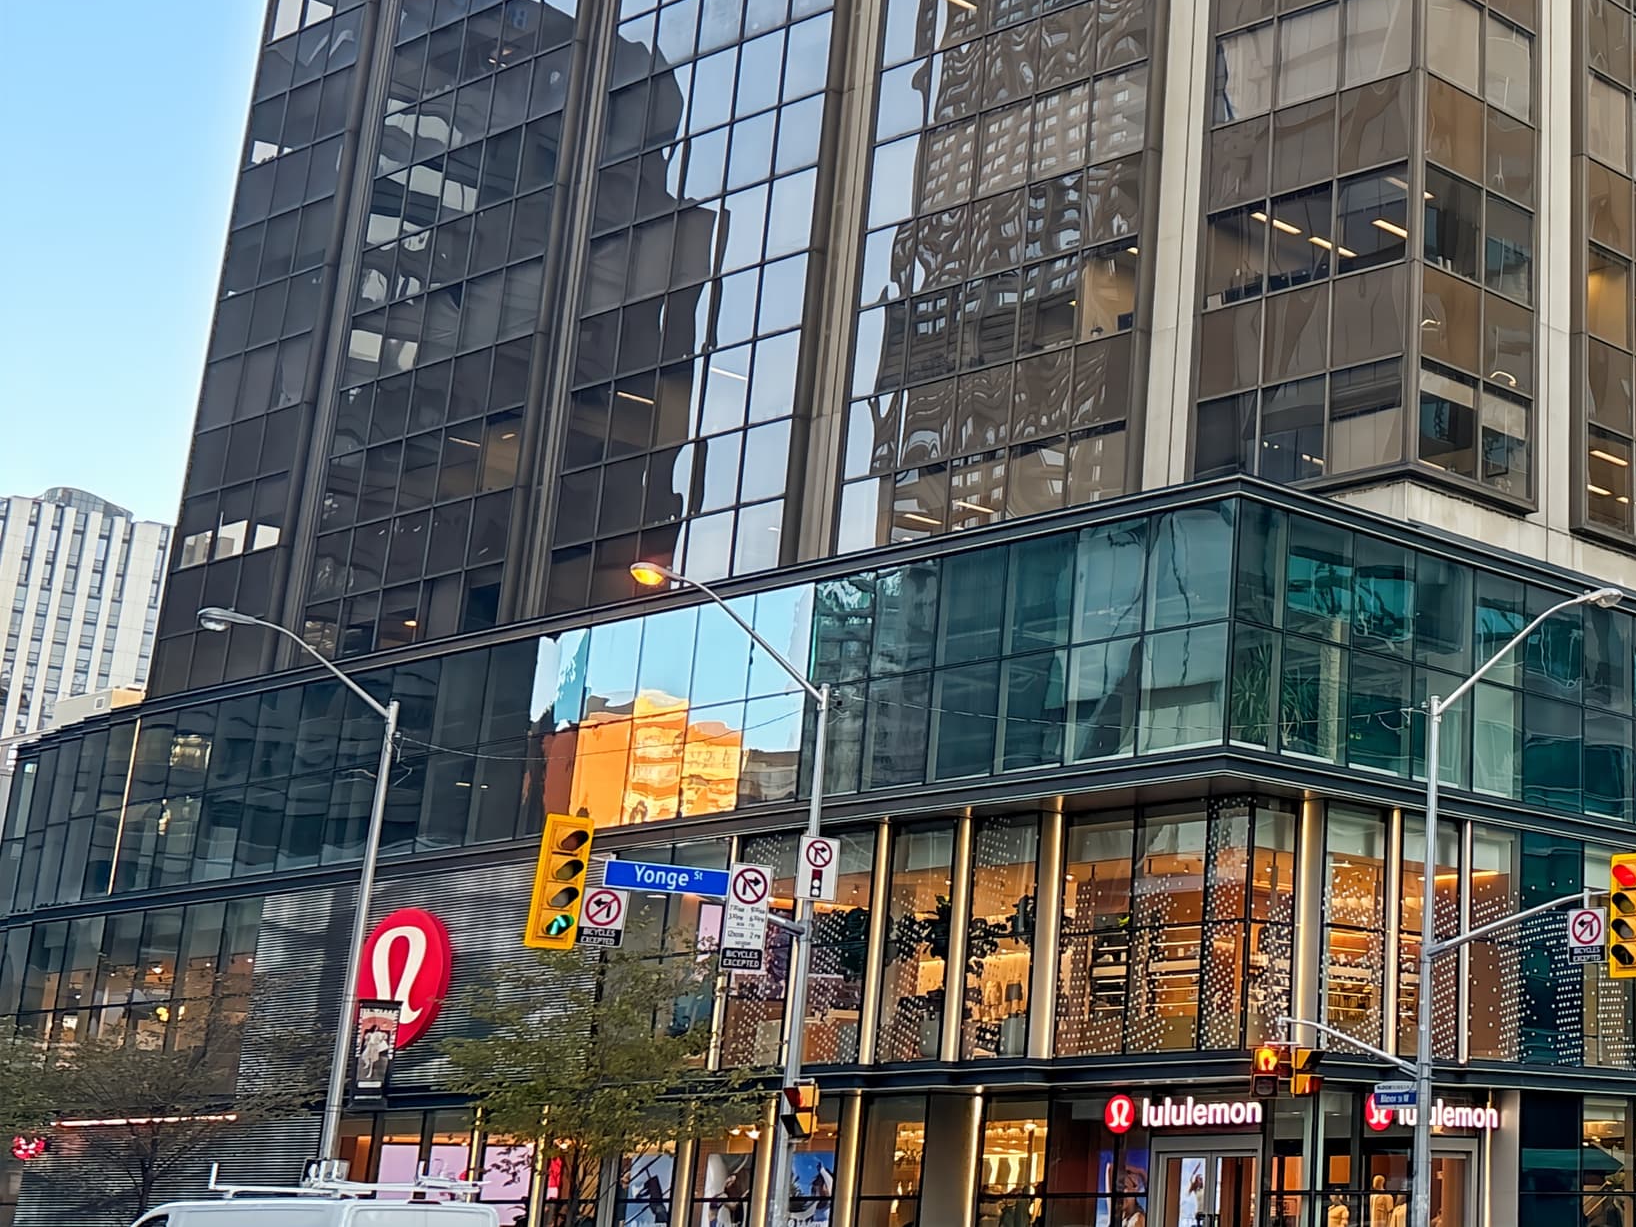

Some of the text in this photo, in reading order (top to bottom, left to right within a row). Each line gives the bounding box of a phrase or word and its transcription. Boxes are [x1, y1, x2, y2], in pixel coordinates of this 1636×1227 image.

[634, 865, 703, 890] Yonge St
[583, 927, 615, 937] BICYCLES
[580, 935, 615, 946] EXCEPTED
[725, 949, 759, 959] BICYCLES
[722, 958, 760, 968] EXCEPTED
[1141, 1096, 1263, 1127] lululemon
